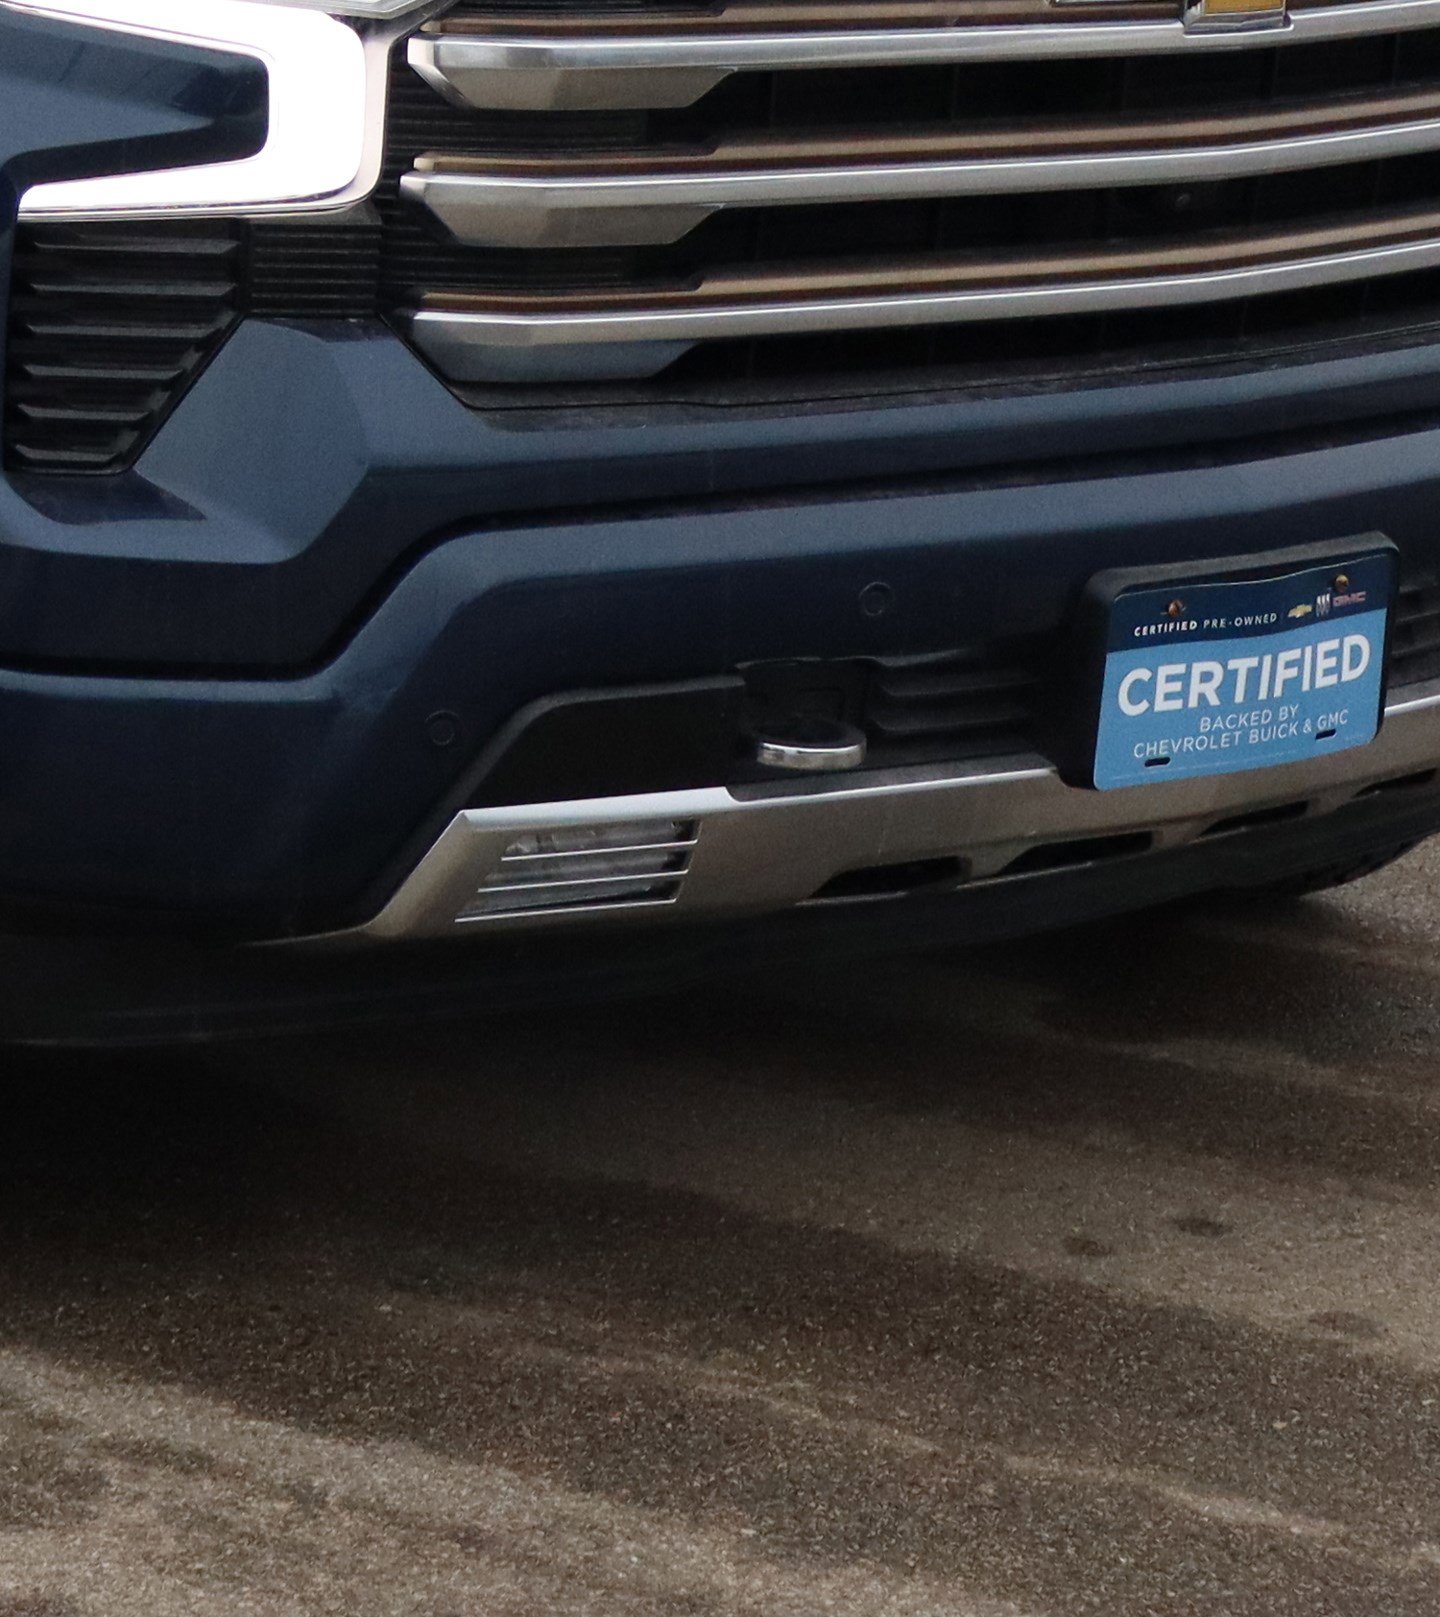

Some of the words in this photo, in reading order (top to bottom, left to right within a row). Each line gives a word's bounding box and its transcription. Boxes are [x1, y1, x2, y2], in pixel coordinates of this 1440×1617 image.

[1332, 591, 1367, 607] GMC
[1133, 619, 1198, 637] CERTIFIED
[1203, 612, 1278, 630] PRE-OWNED
[1118, 634, 1370, 717] CERTIFIED
[1200, 709, 1272, 733] BACKED
[1277, 704, 1299, 720] BY
[1133, 732, 1242, 759] CHEVROLET
[1249, 723, 1299, 744] BUICK
[1302, 718, 1313, 734] &
[1317, 709, 1349, 731] GMC
